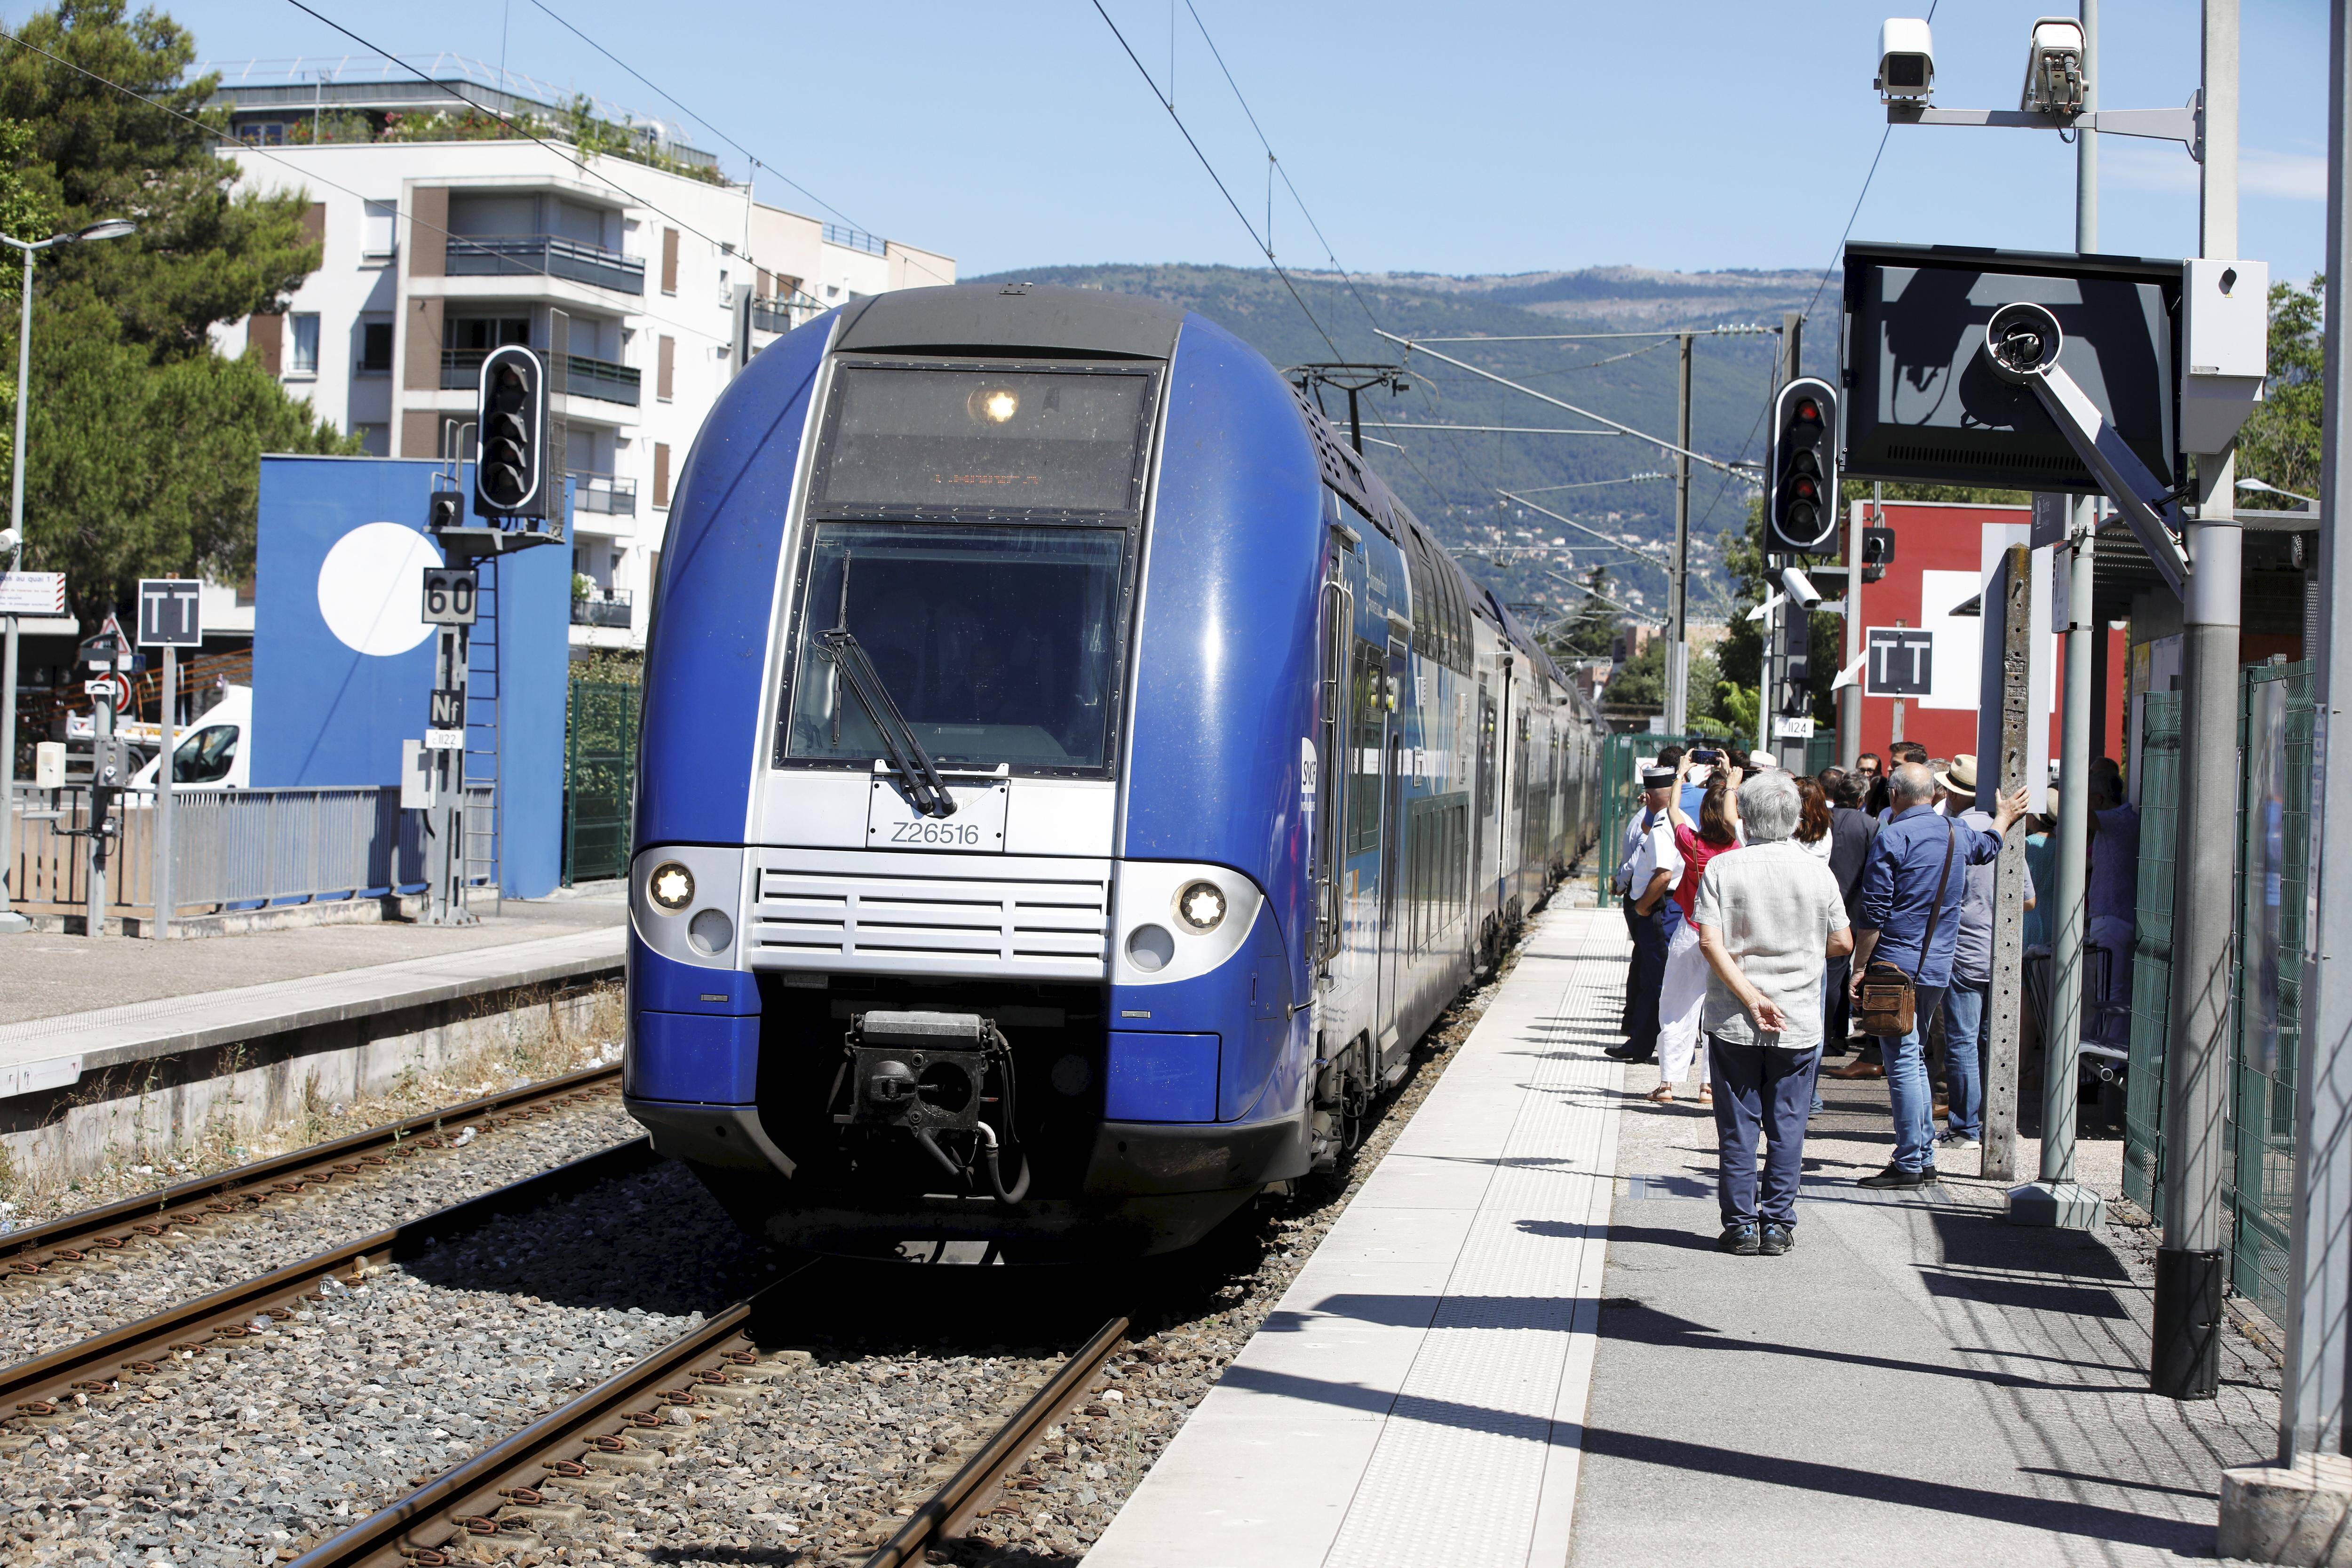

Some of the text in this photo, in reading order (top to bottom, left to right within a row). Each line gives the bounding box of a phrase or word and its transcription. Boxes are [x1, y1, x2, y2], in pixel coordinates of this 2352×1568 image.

[428, 576, 473, 614] 60
[143, 591, 199, 634] TT
[1871, 639, 1931, 685] TT
[432, 694, 460, 722] Nf
[1303, 760, 1317, 786] SNCF
[891, 822, 979, 845] Z26516
